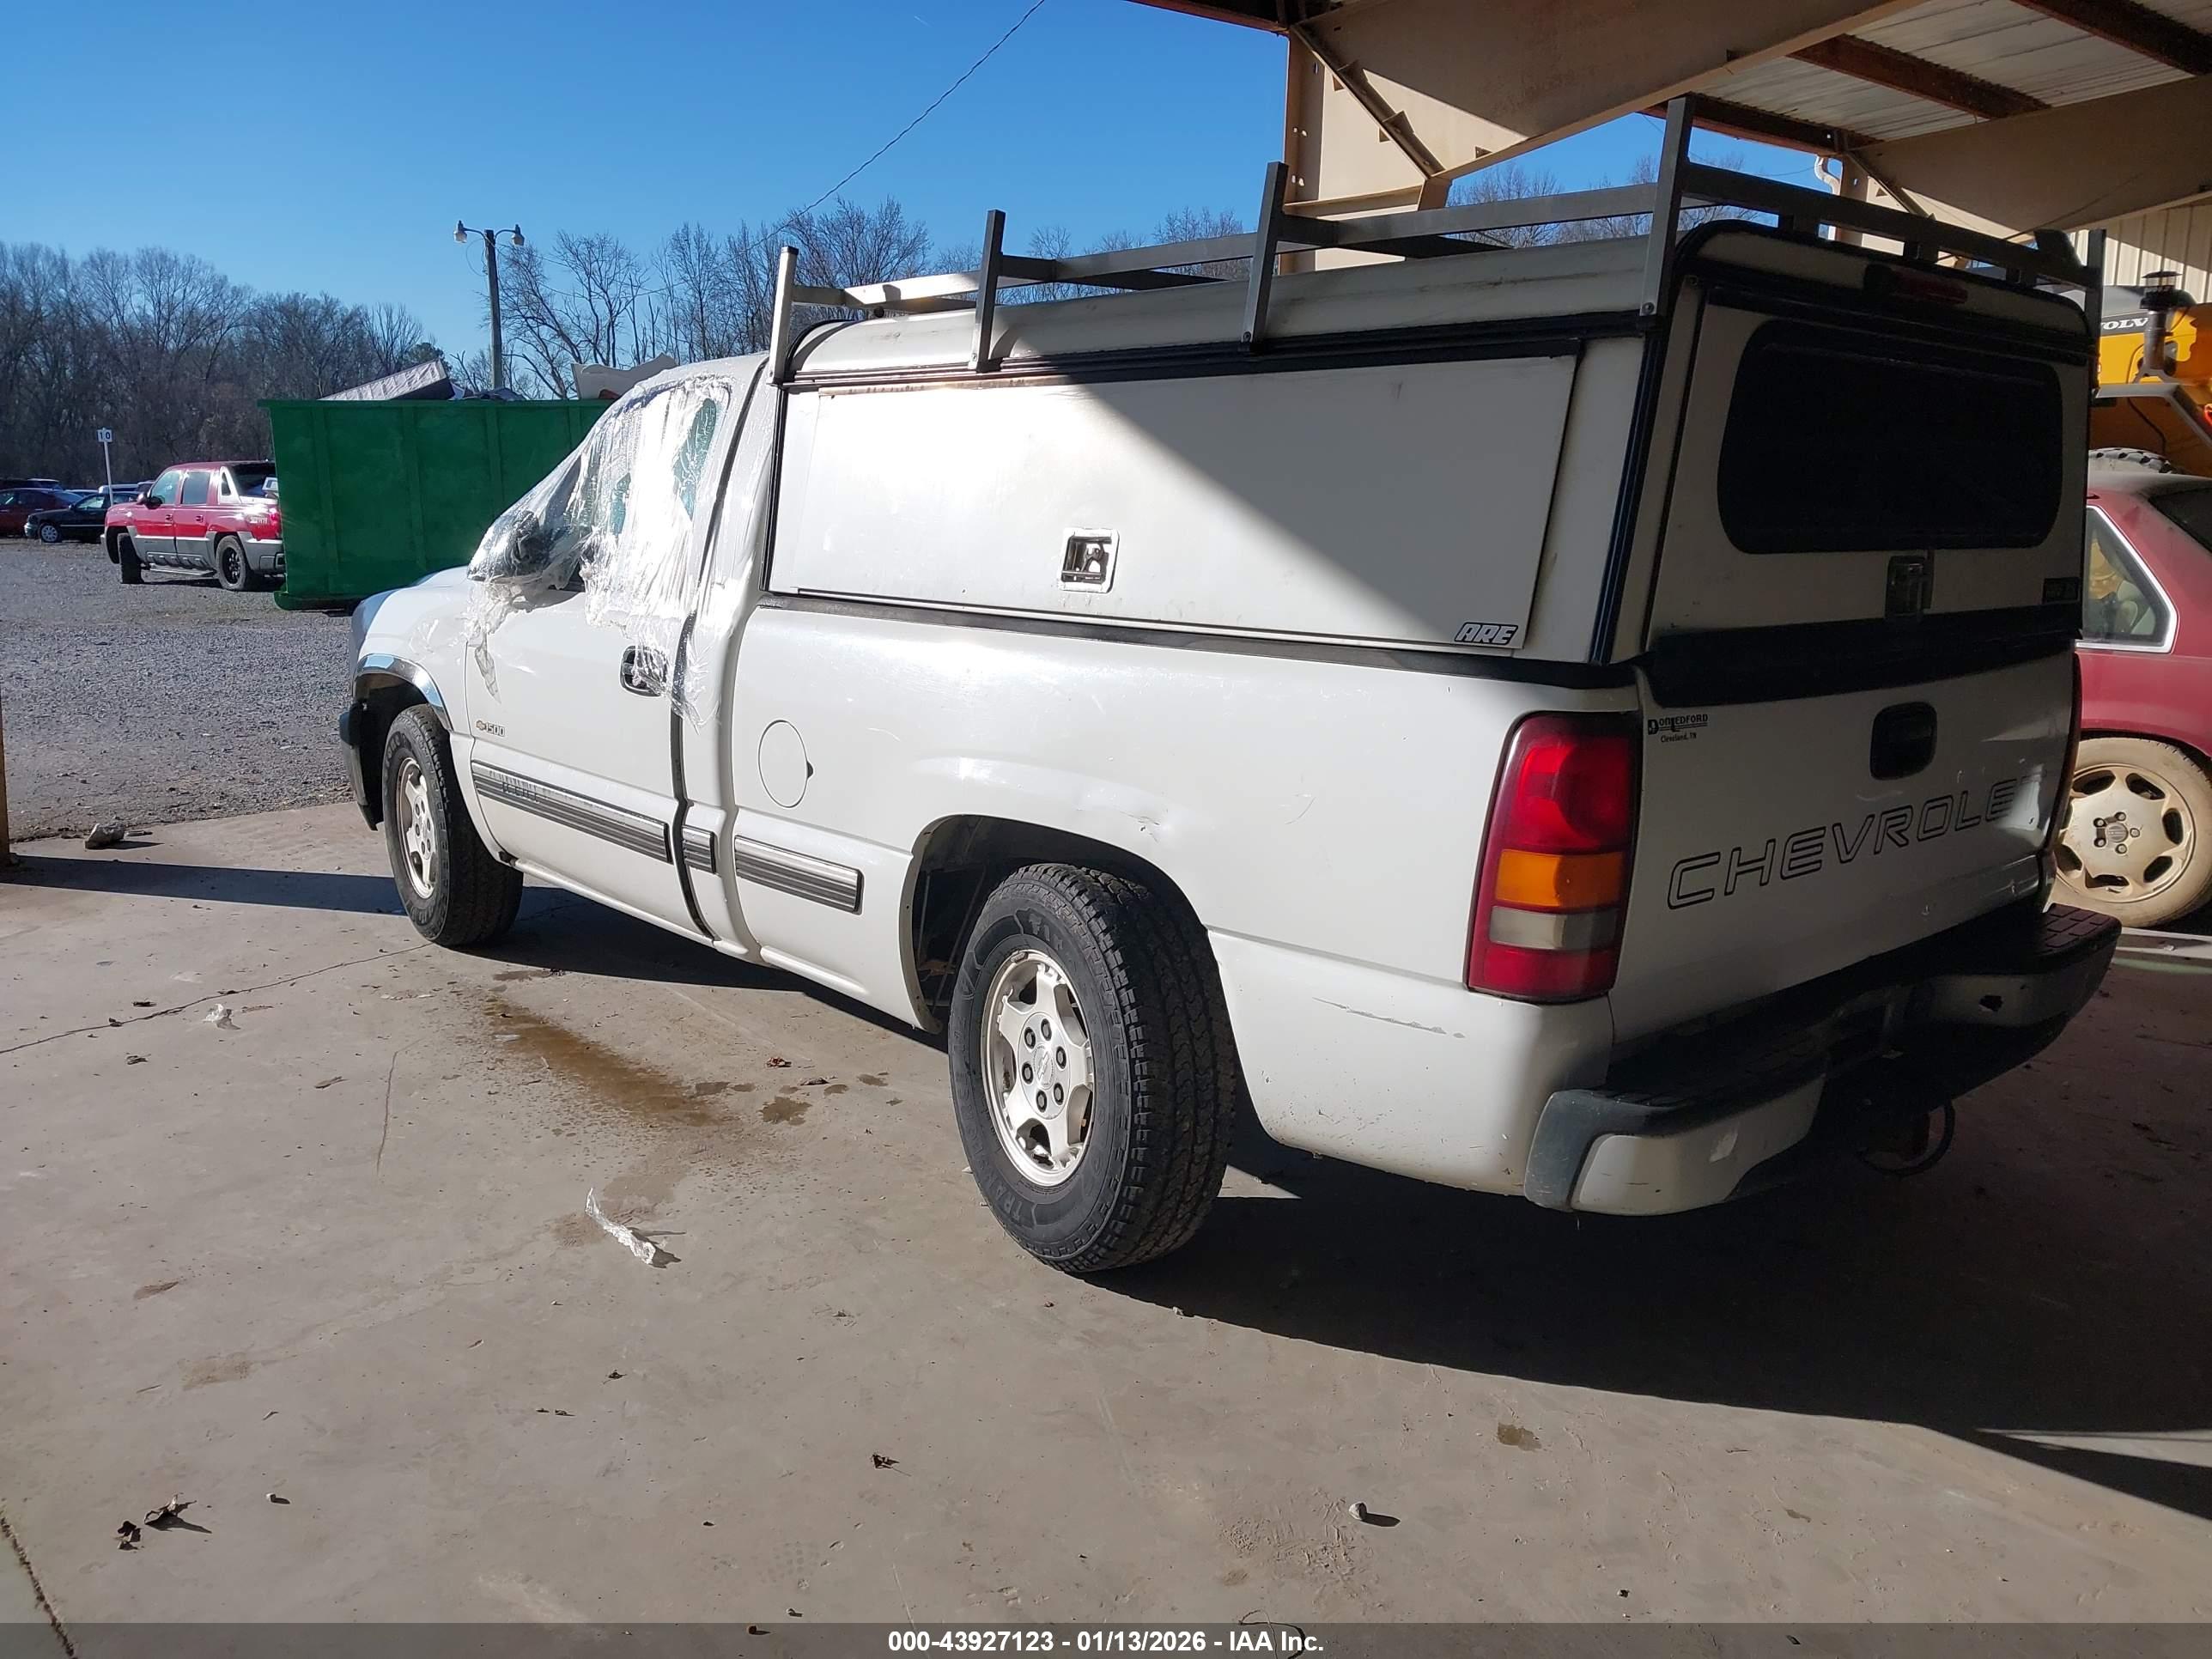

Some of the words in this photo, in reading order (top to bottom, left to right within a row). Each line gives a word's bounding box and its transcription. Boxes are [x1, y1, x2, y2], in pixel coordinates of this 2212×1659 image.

[2100, 317, 2148, 330] OLV
[1455, 623, 1518, 645] ARE
[486, 722, 505, 738] 1500
[1668, 769, 2047, 910] CHEVROLE
